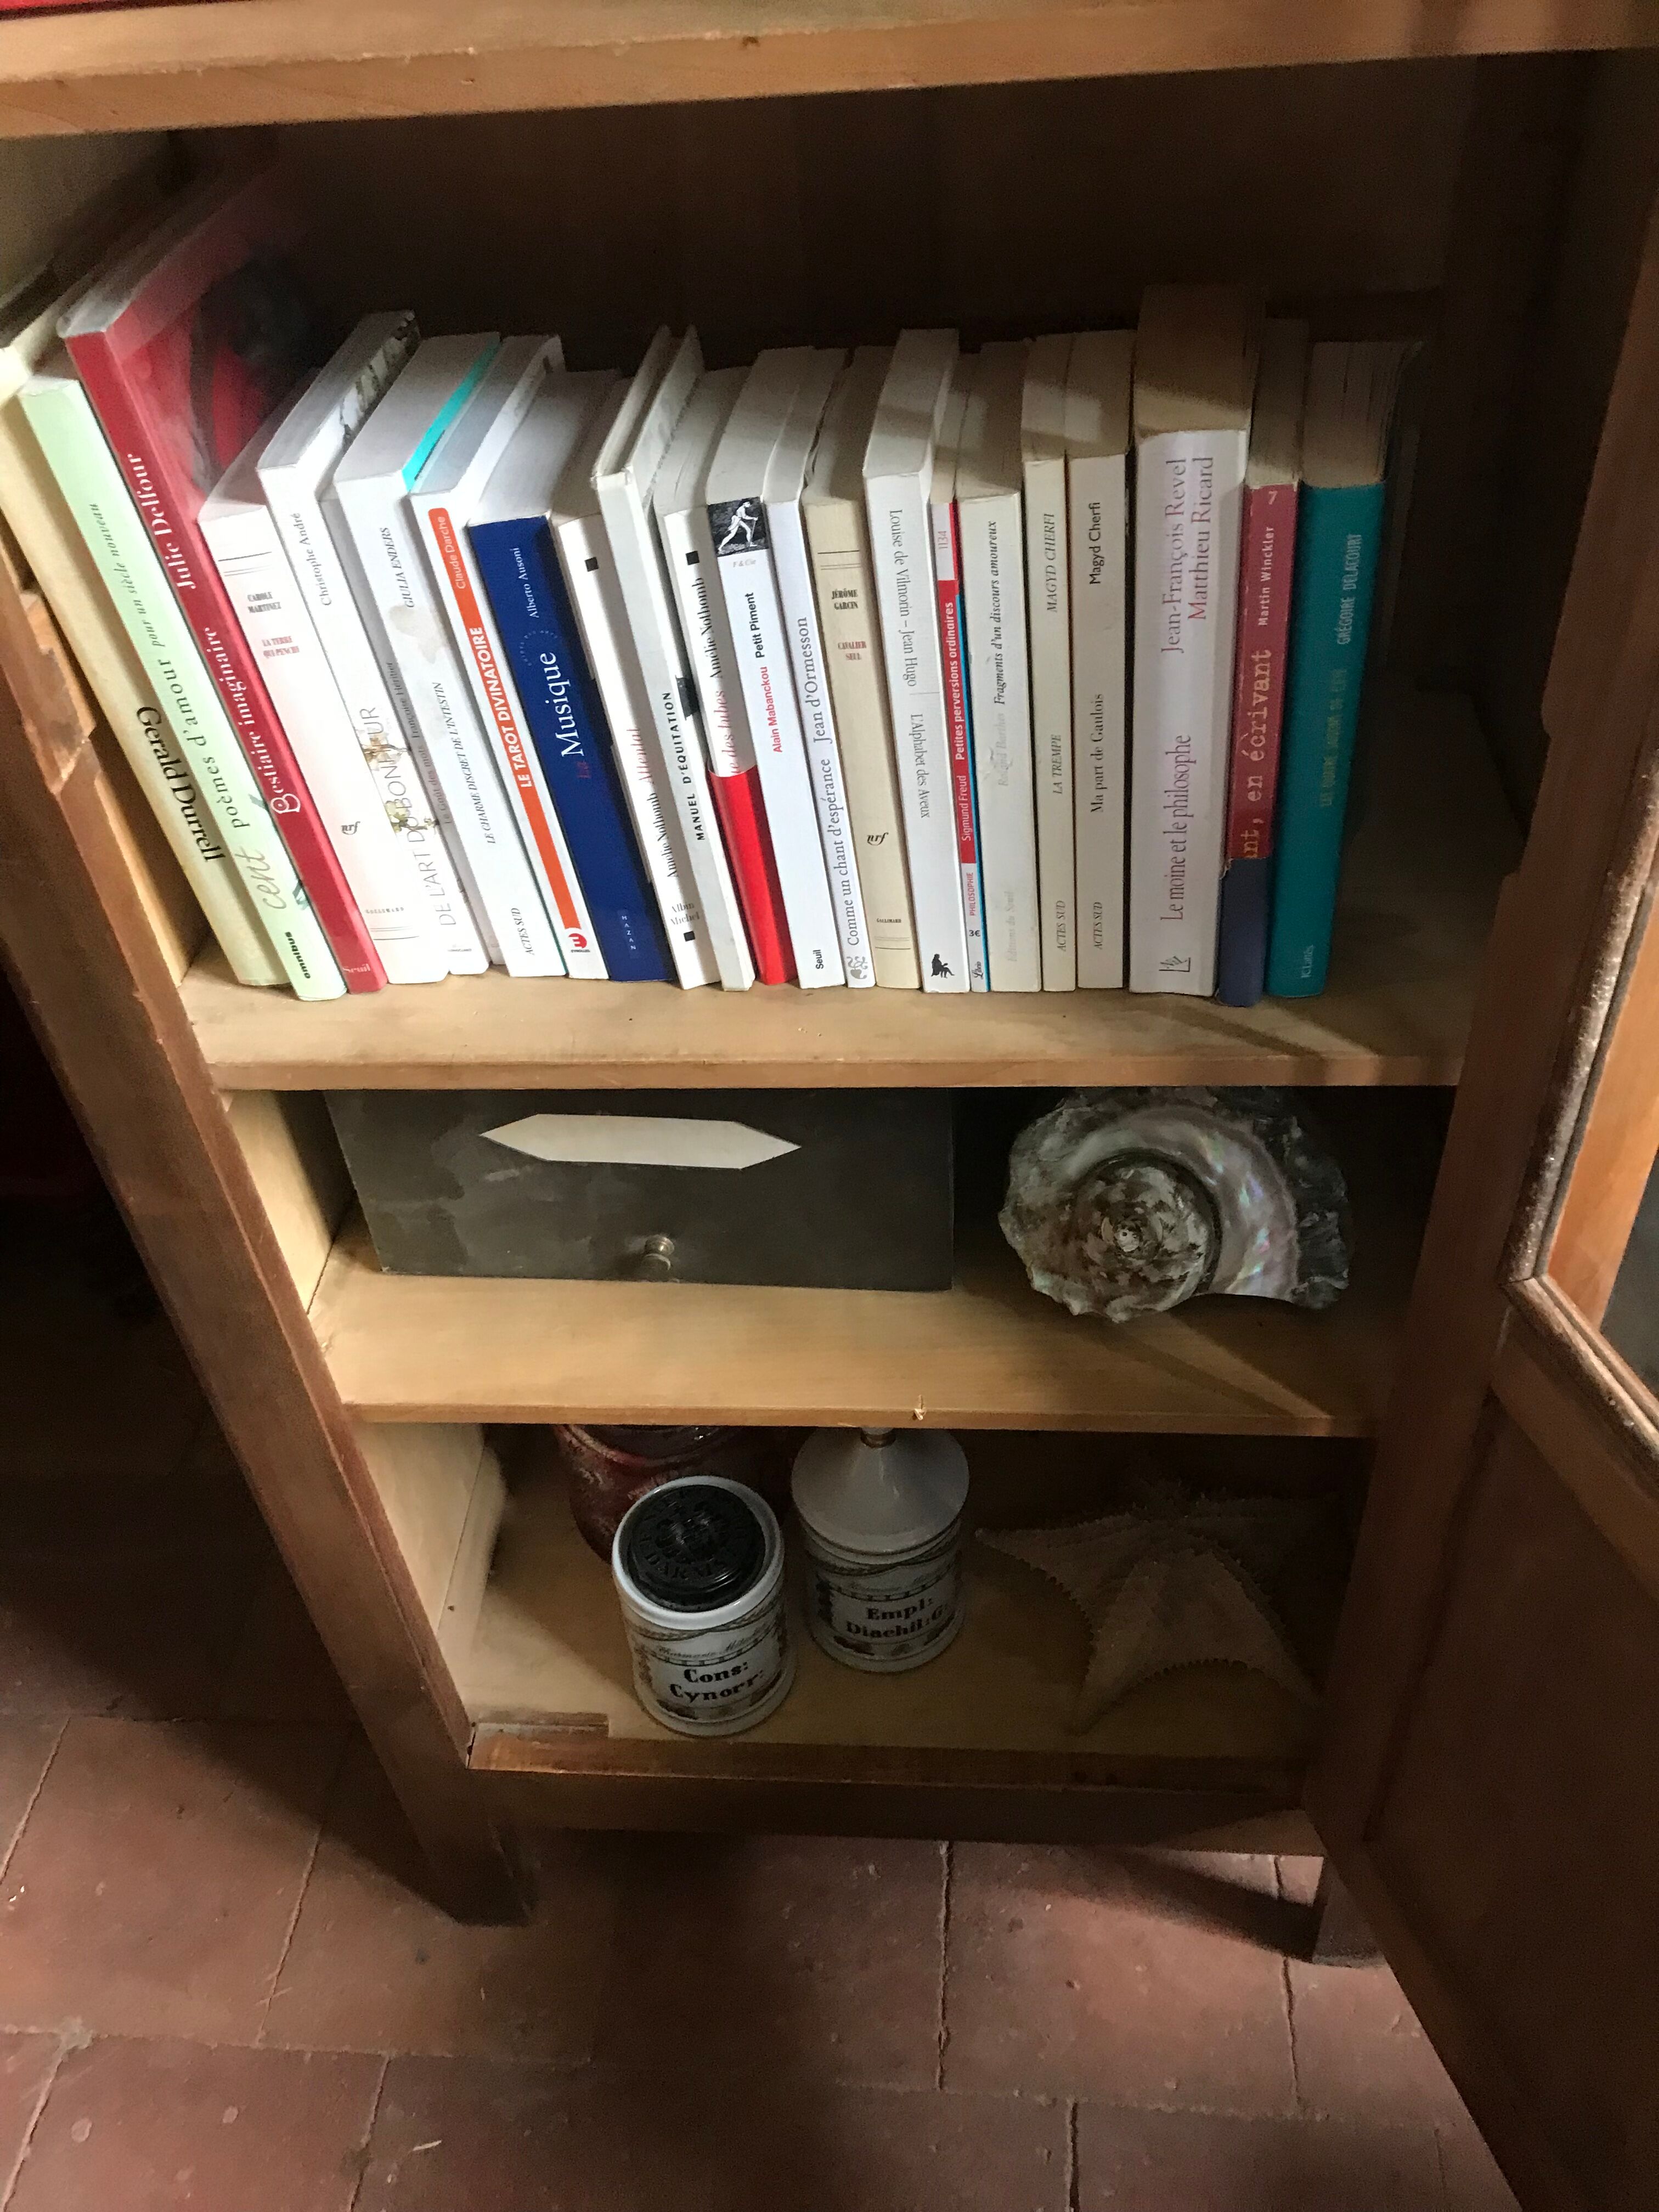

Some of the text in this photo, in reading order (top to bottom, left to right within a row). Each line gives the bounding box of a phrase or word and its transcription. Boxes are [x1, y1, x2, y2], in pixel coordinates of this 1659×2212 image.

[127, 454, 196, 589] Julie Delfour
[290, 513, 332, 606] Christophe André
[438, 516, 466, 589] Claude Darche
[889, 509, 905, 548] Louise
[894, 550, 909, 565] de
[938, 531, 948, 549] 1134
[1088, 501, 1105, 585] Magyd Cherfi
[1161, 459, 1188, 653] Jean-François Revel
[1188, 457, 1213, 620] Matthieu Ricard
[89, 503, 165, 648] pour un siècle nouveau
[379, 527, 415, 608] GIULIA ENDERS
[510, 548, 540, 619] Alberto Ausoni
[896, 568, 913, 618] Vilmorin
[1044, 514, 1058, 613] MAGYD CHERFI
[1258, 527, 1274, 626] Martin Winckler
[1334, 534, 1363, 645] GRÉGOIRE DELACOURT
[692, 577, 714, 636] Nothomb
[745, 592, 765, 659] Petit Piment
[899, 629, 915, 654] Jean
[988, 521, 1007, 705] Fragments d'un discours amoureux
[469, 627, 533, 788] LE TAROT DIVINATOIRE
[540, 652, 584, 757] Musique
[714, 691, 730, 729] tubes
[760, 667, 782, 753] Alain Mabanckou
[797, 617, 833, 744] Jean d'Ormesson
[903, 656, 917, 687] Hugo
[944, 602, 964, 760] Petites perversions ordinaires
[1241, 649, 1272, 761] écrivant
[157, 659, 251, 828] poèmes d'amour
[204, 627, 301, 814] Bestiaire imaginaire
[721, 735, 735, 762] des
[1090, 694, 1108, 813] Ma part de Gaulois
[137, 706, 226, 862] Gerald Durrell
[432, 682, 496, 844] LE CHARME DISCRET DE L'INTESTIN
[662, 692, 706, 840] MANUEL D'EQUITATION
[909, 713, 930, 819] L'Alphabet des Aveux
[1052, 734, 1063, 795] LA TREMPE
[1248, 775, 1262, 802] en
[867, 832, 889, 846] nrf
[959, 774, 971, 842] Sigmund Freud
[1160, 734, 1197, 921] Le moine et le philosophe
[413, 851, 445, 896] L'ART
[821, 759, 860, 946] Comme un chant d'espérance
[436, 903, 456, 925] DE
[511, 907, 535, 956] ACTES SUD
[622, 915, 636, 950] HAZAN
[1056, 900, 1066, 952] ACTES SUD
[1093, 901, 1103, 950] ACTES SUD
[285, 932, 311, 979] omnibus
[813, 949, 824, 969] Seuil
[684, 1662, 749, 1683] Cons:
